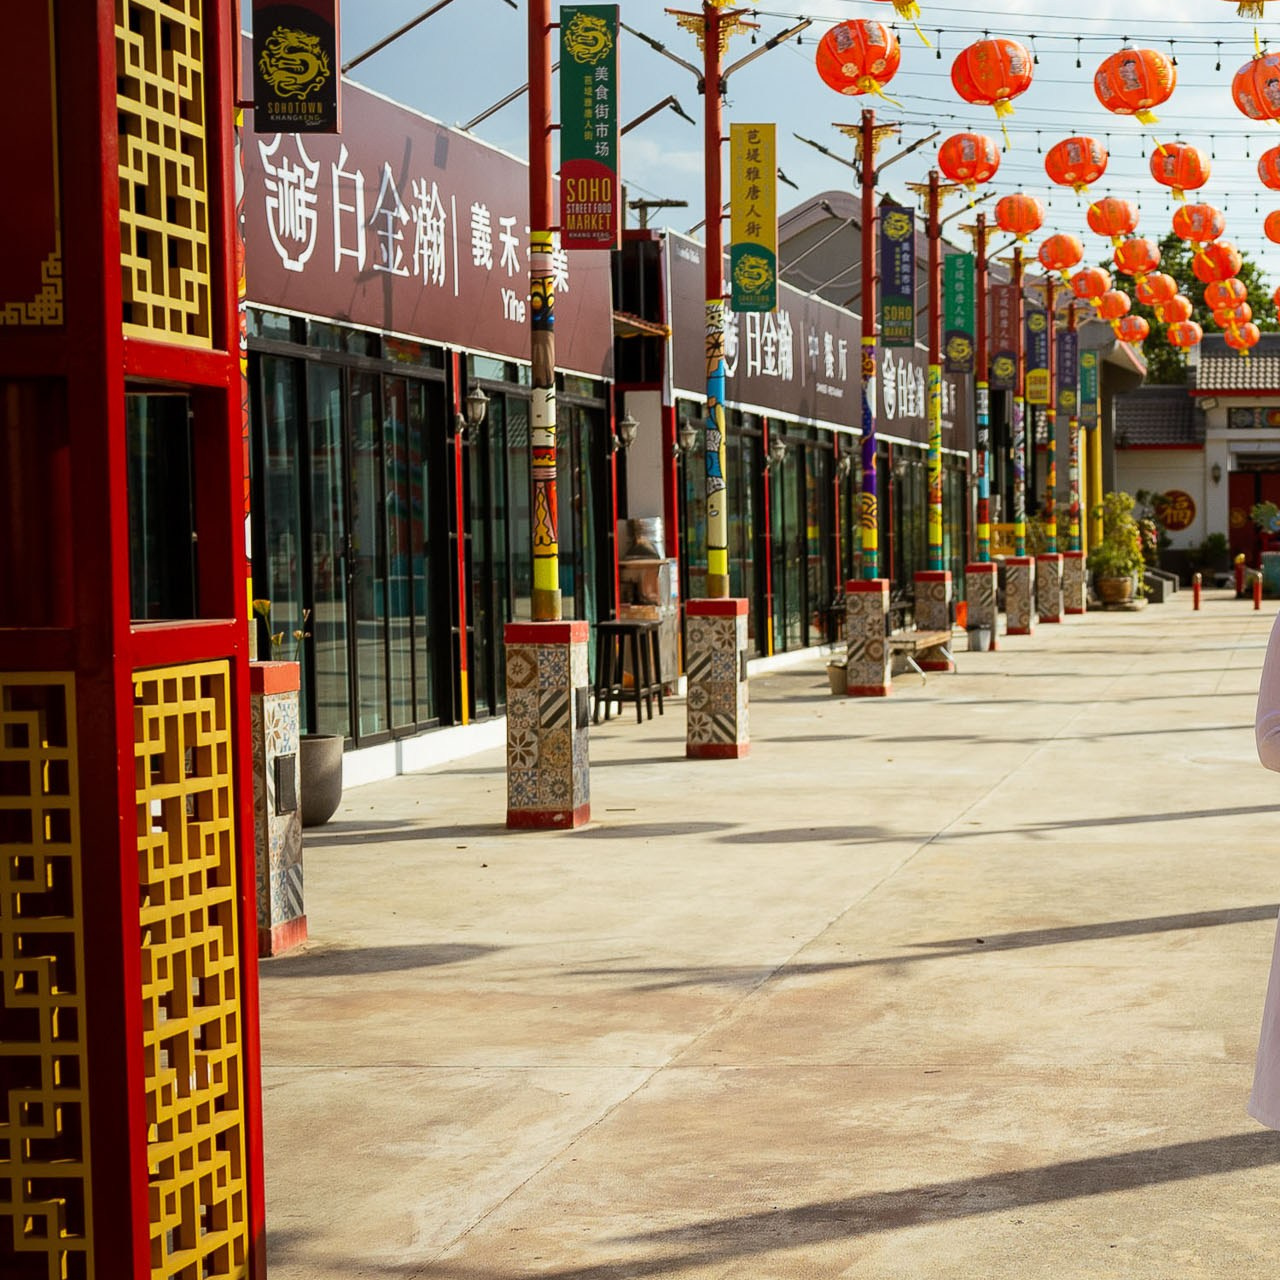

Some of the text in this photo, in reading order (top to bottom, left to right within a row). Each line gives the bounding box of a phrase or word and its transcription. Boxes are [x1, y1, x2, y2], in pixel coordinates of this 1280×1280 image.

[267, 102, 323, 114] SOHOTOWN
[595, 66, 610, 157] 美食街市场
[566, 178, 611, 202] SOHO
[745, 129, 762, 238] 芭堤雅唐人街
[331, 144, 447, 288] 白金瀚
[566, 203, 592, 214] STREET
[567, 214, 612, 231] MARKET
[884, 306, 912, 320] SOHO
